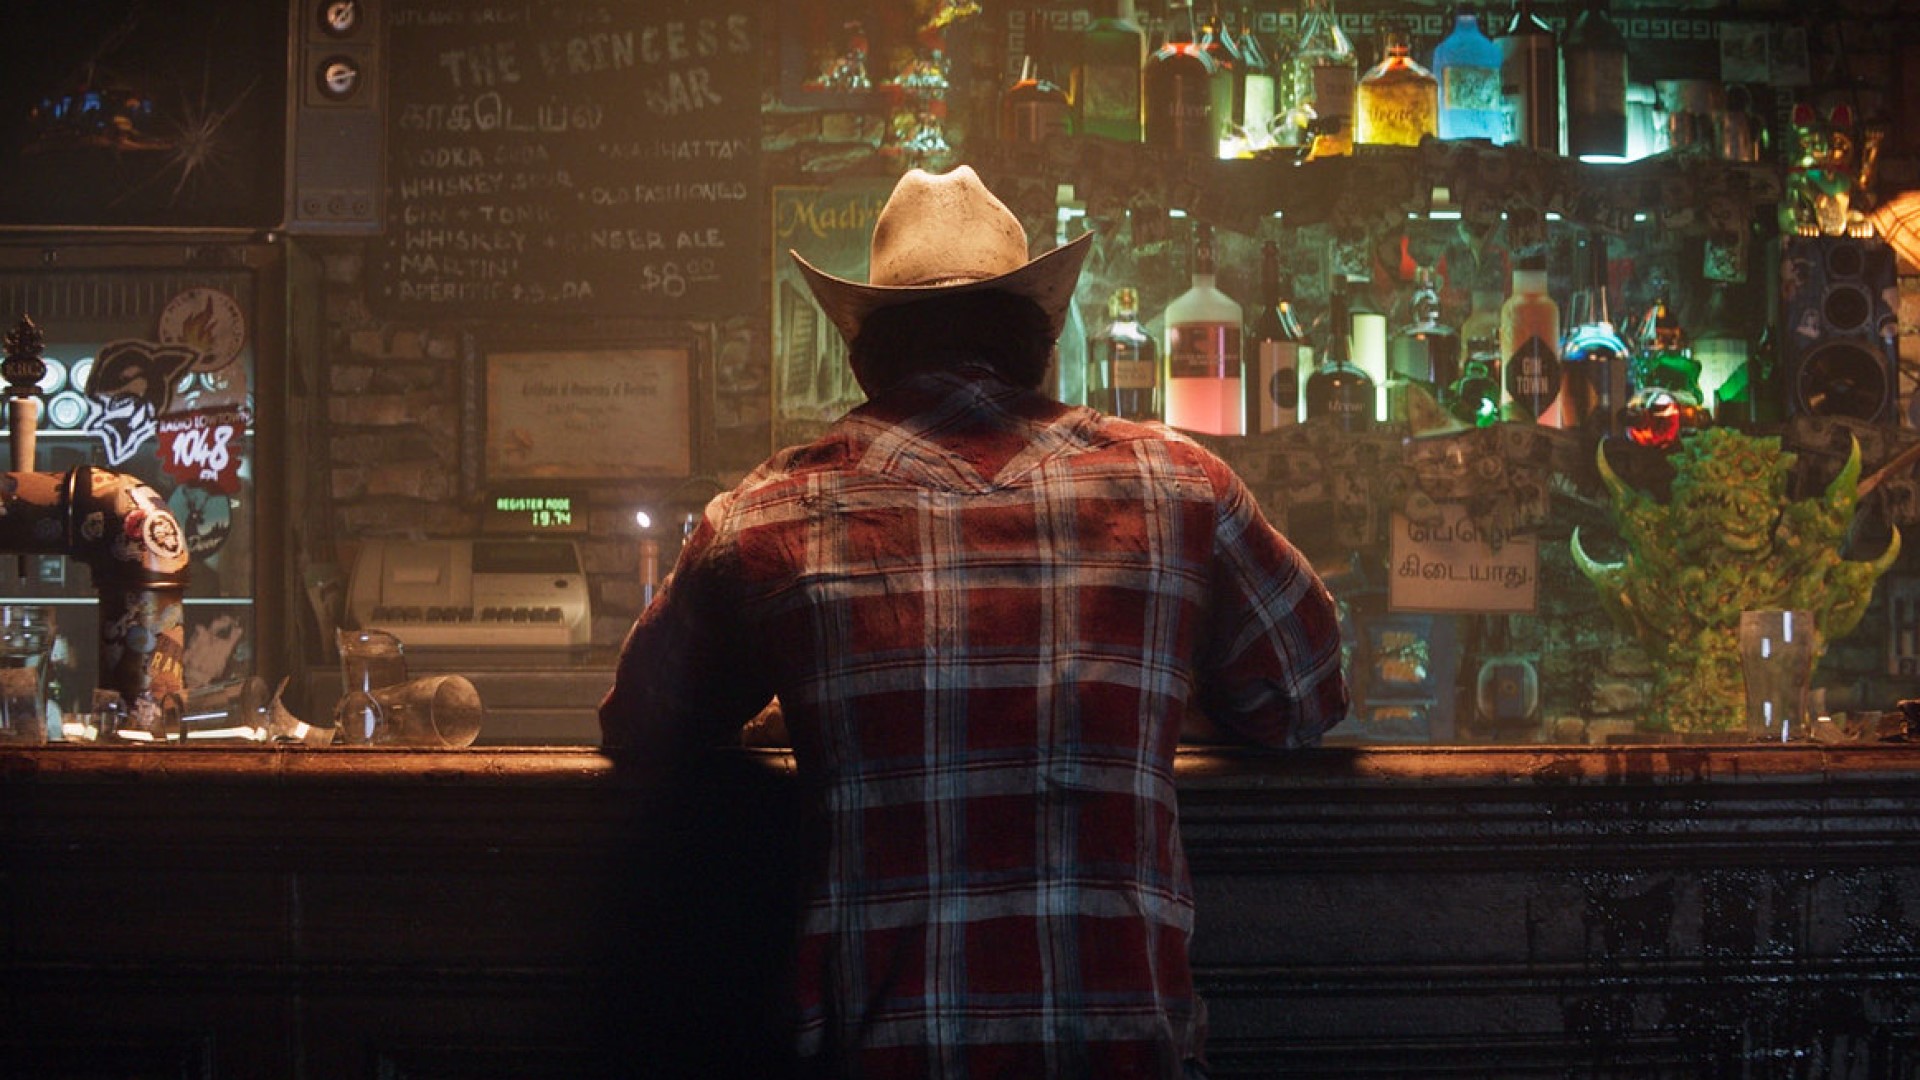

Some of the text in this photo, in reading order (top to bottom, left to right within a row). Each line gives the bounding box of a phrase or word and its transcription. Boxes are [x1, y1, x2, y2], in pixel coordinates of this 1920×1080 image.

[439, 13, 753, 87] THE PRINCESS
[644, 67, 722, 116] BAR
[403, 147, 485, 168] ODKA
[400, 172, 504, 200] WHISKEY
[635, 181, 748, 204] FASHIONED
[404, 204, 446, 225] GIN
[405, 229, 527, 253] WHISKEY
[564, 229, 666, 251] NGER
[677, 228, 725, 250] ALE
[1516, 375, 1549, 396] TOWN
[497, 498, 543, 511] REGISTER
